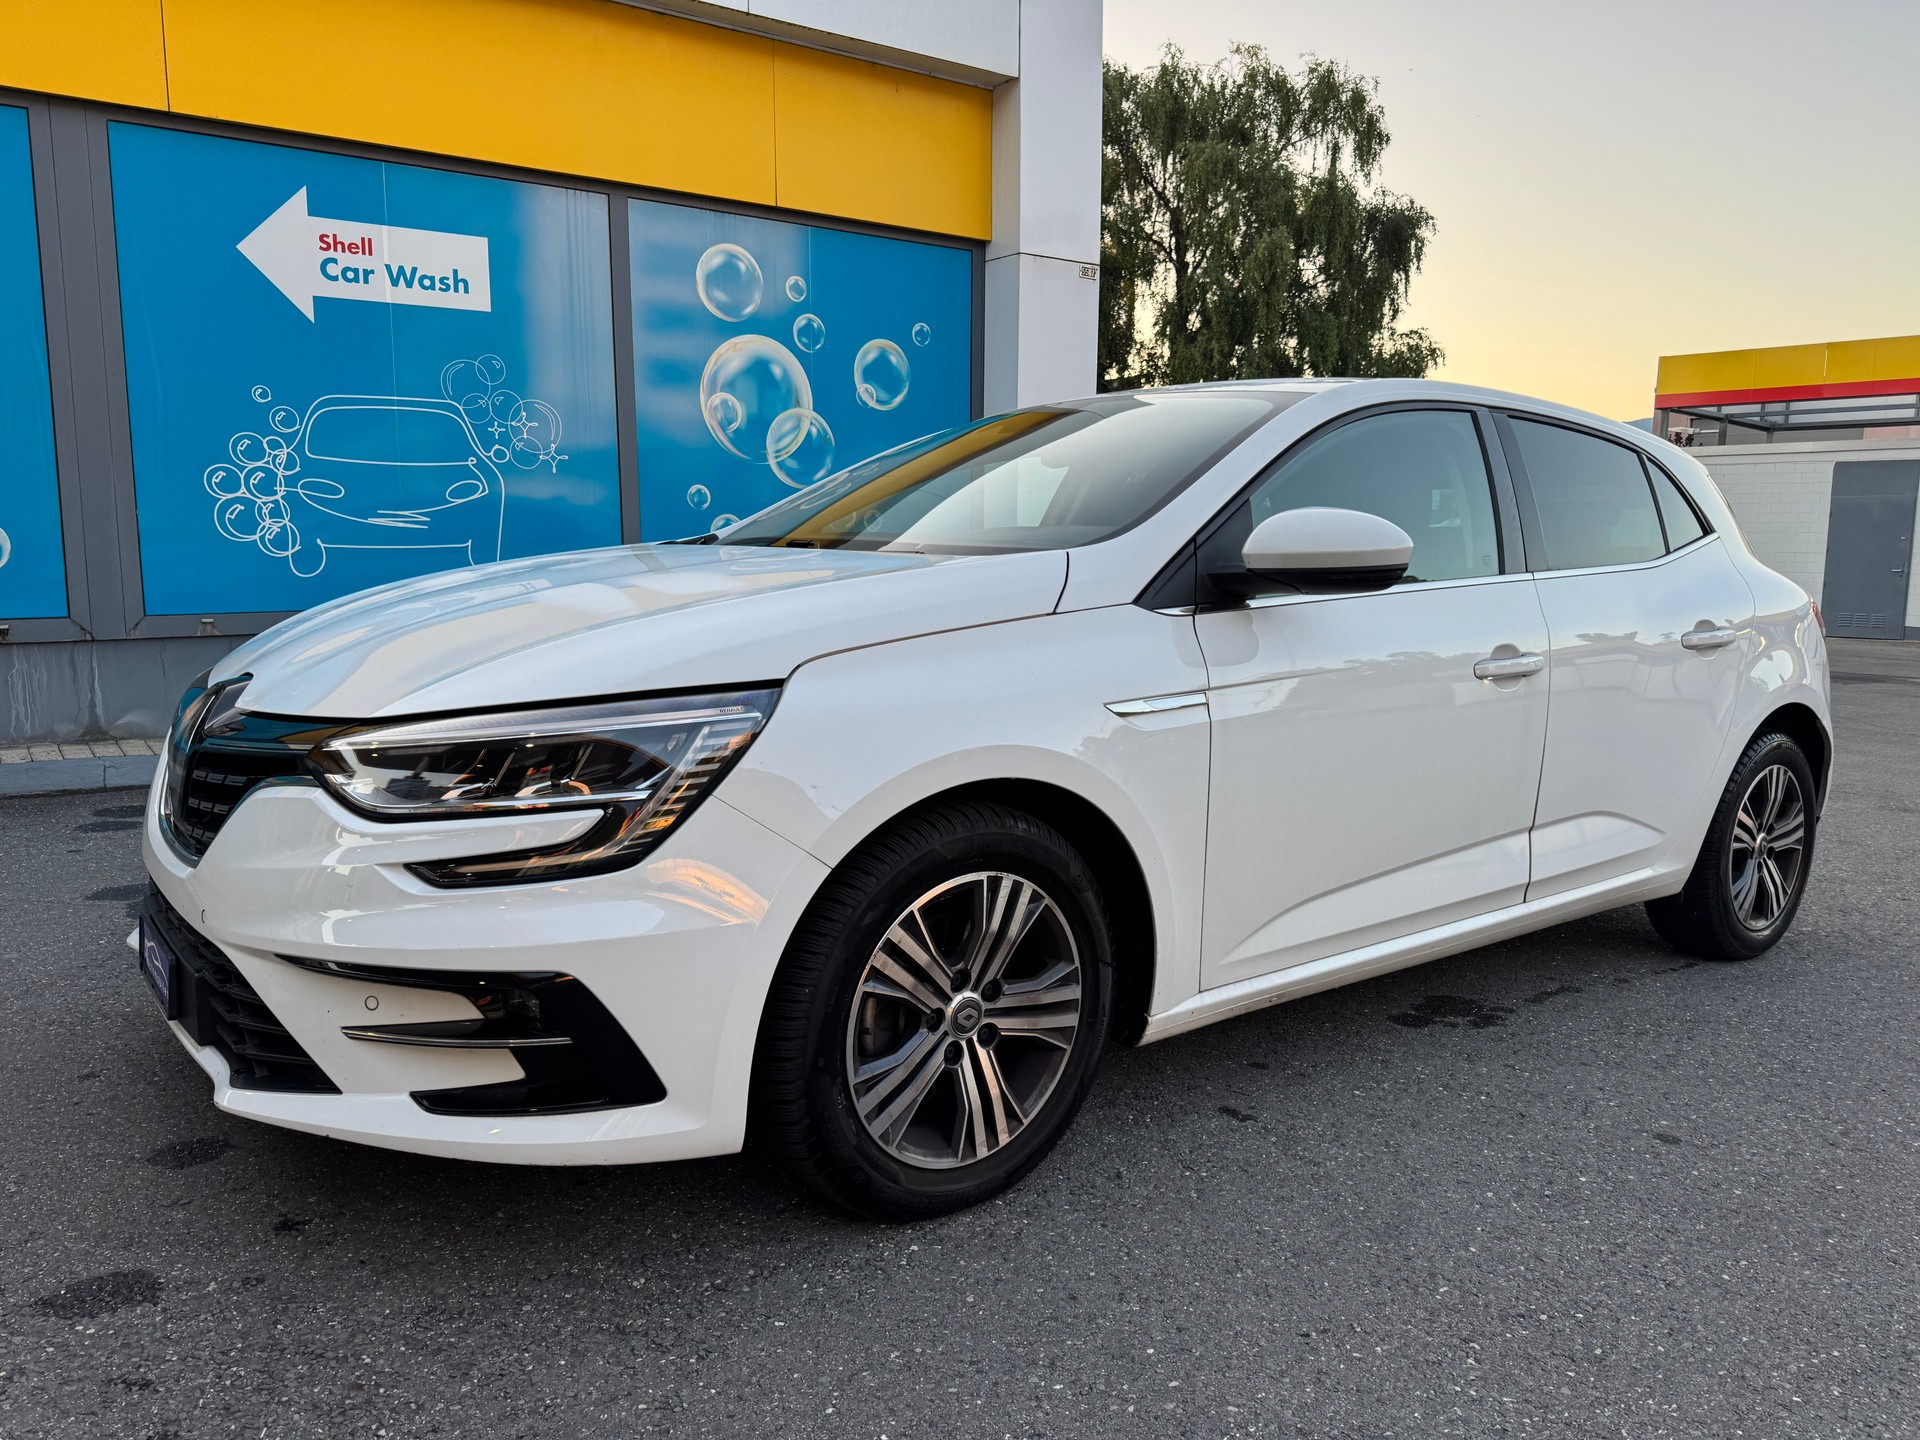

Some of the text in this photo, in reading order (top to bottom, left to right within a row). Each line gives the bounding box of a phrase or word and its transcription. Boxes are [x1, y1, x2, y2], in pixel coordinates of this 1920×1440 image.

[318, 233, 374, 257] Shell
[319, 257, 470, 295] Car Wash
